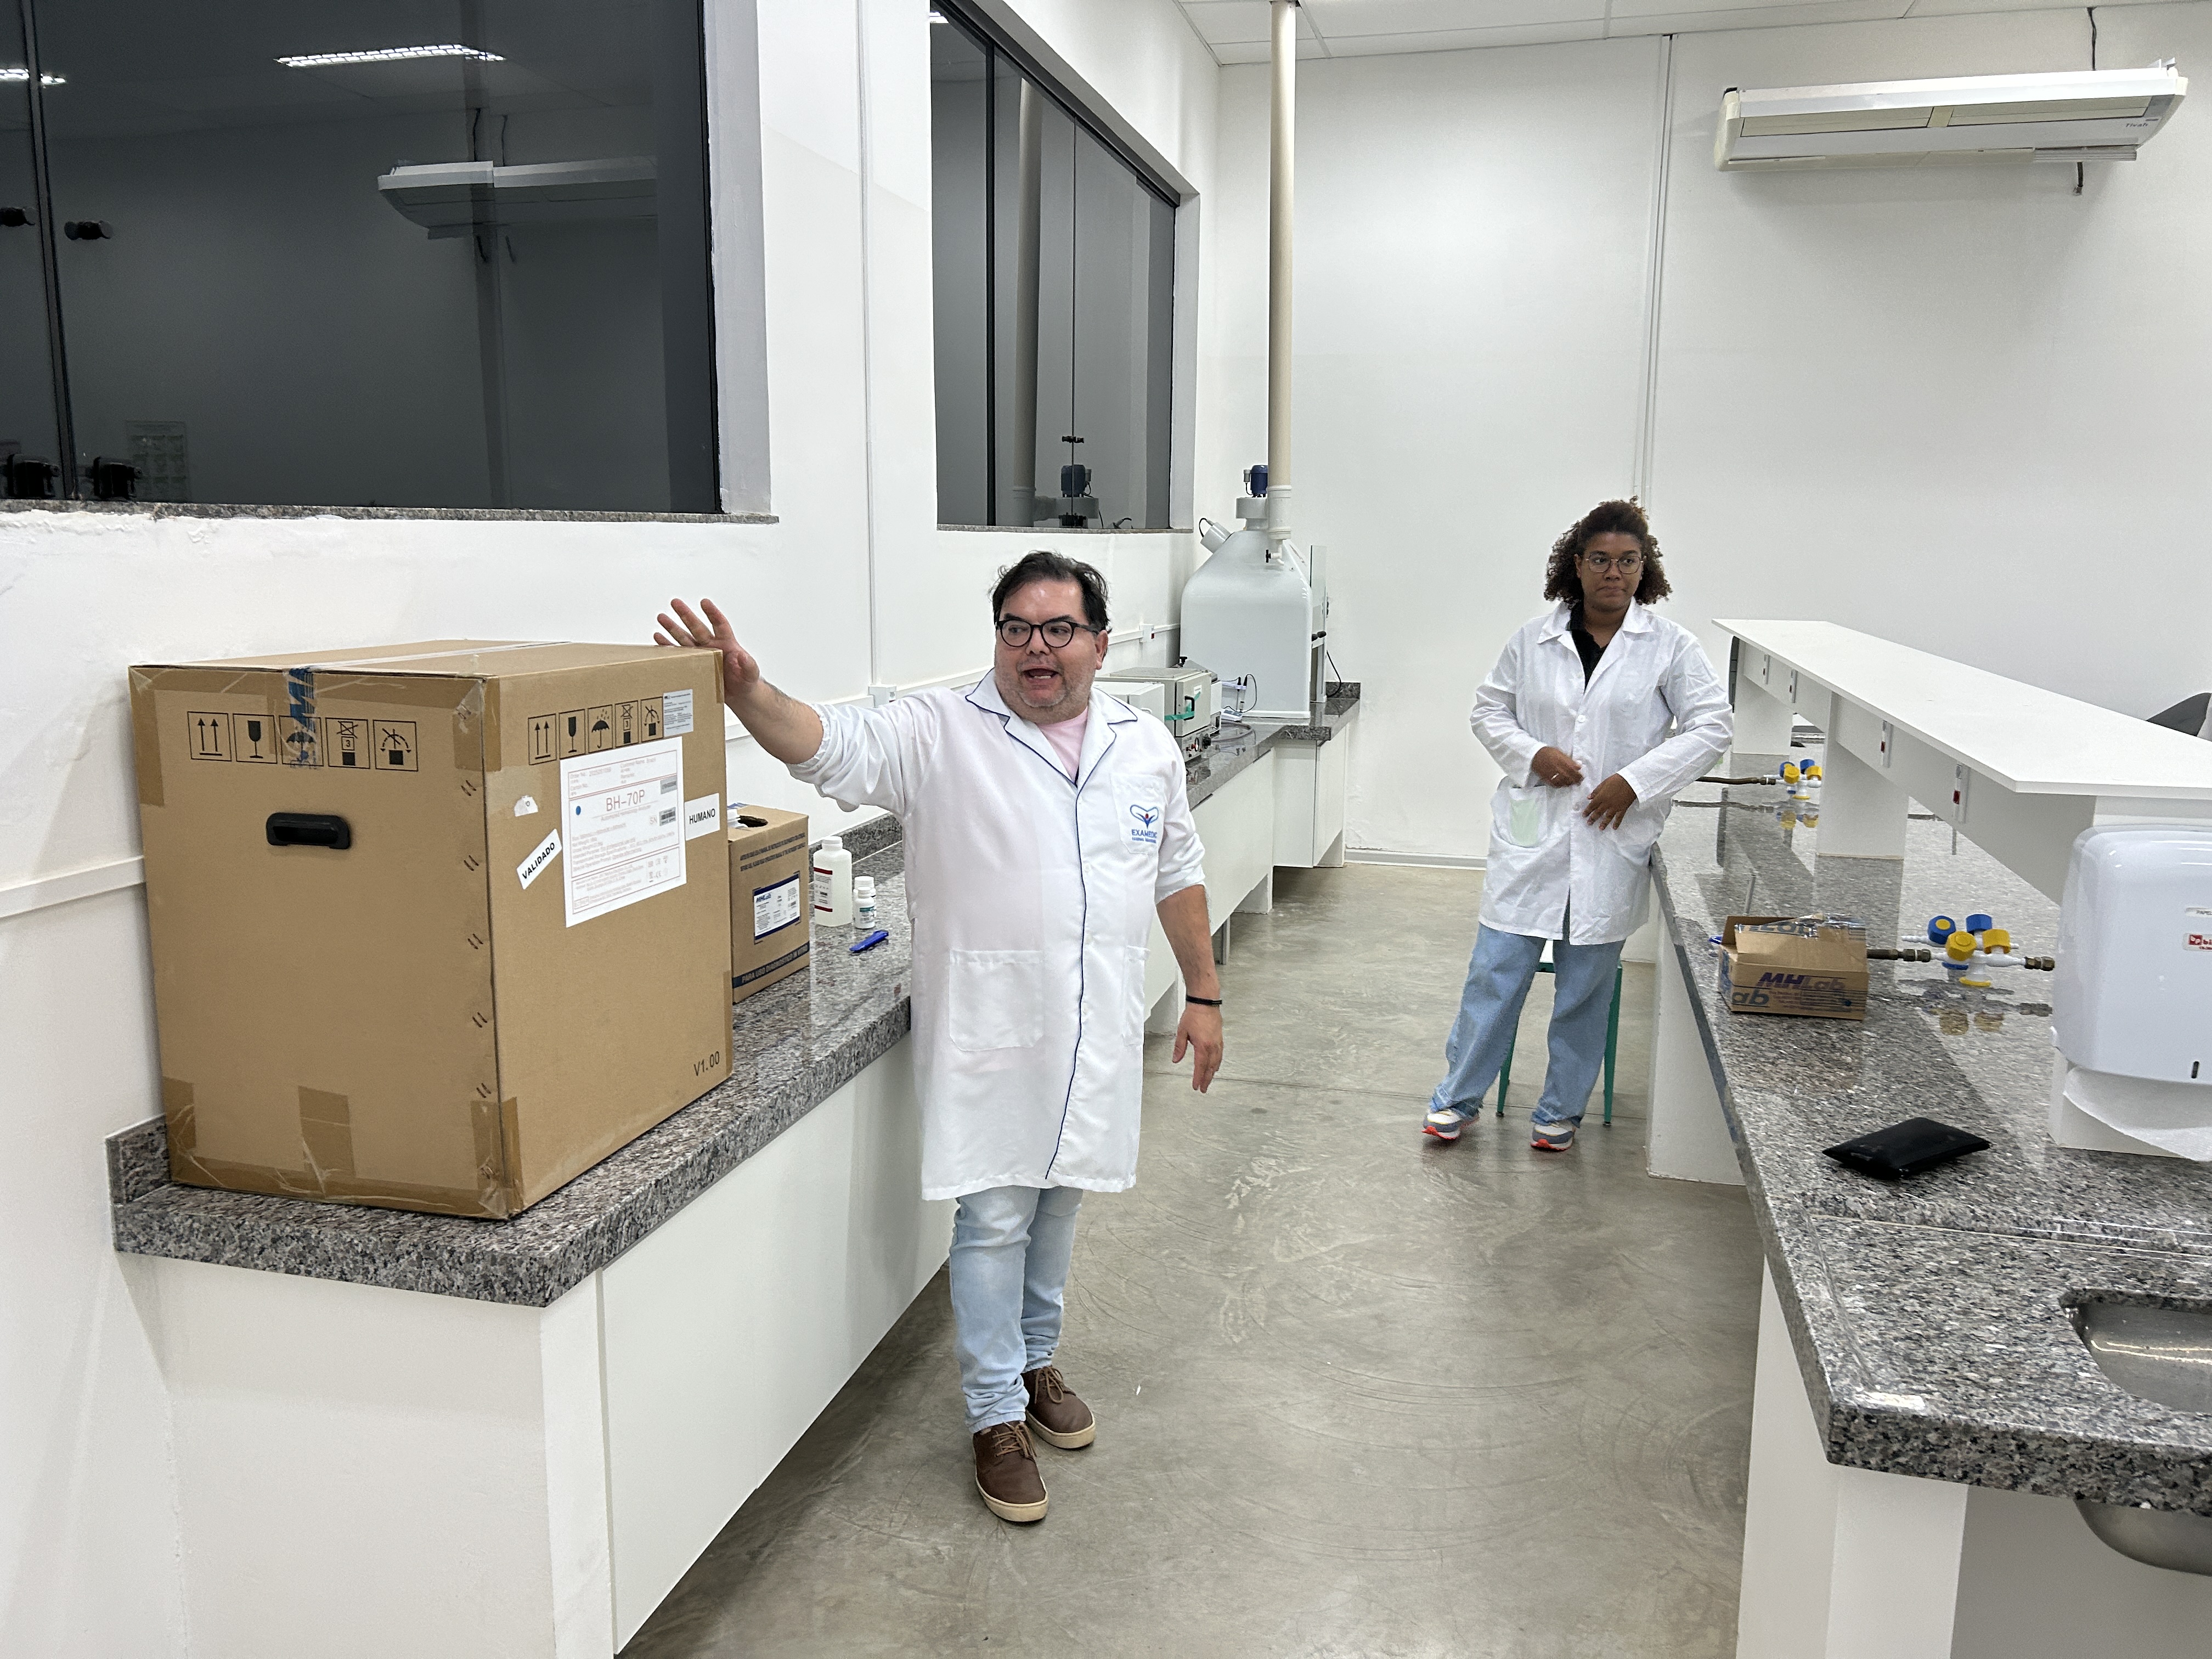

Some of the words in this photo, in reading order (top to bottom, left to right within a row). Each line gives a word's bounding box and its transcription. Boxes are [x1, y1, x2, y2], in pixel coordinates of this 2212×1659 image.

[606, 789, 645, 812] BH-70P
[689, 808, 715, 825] HUMANO
[522, 842, 555, 879] VALIDADO
[693, 1051, 719, 1076] V1.00
